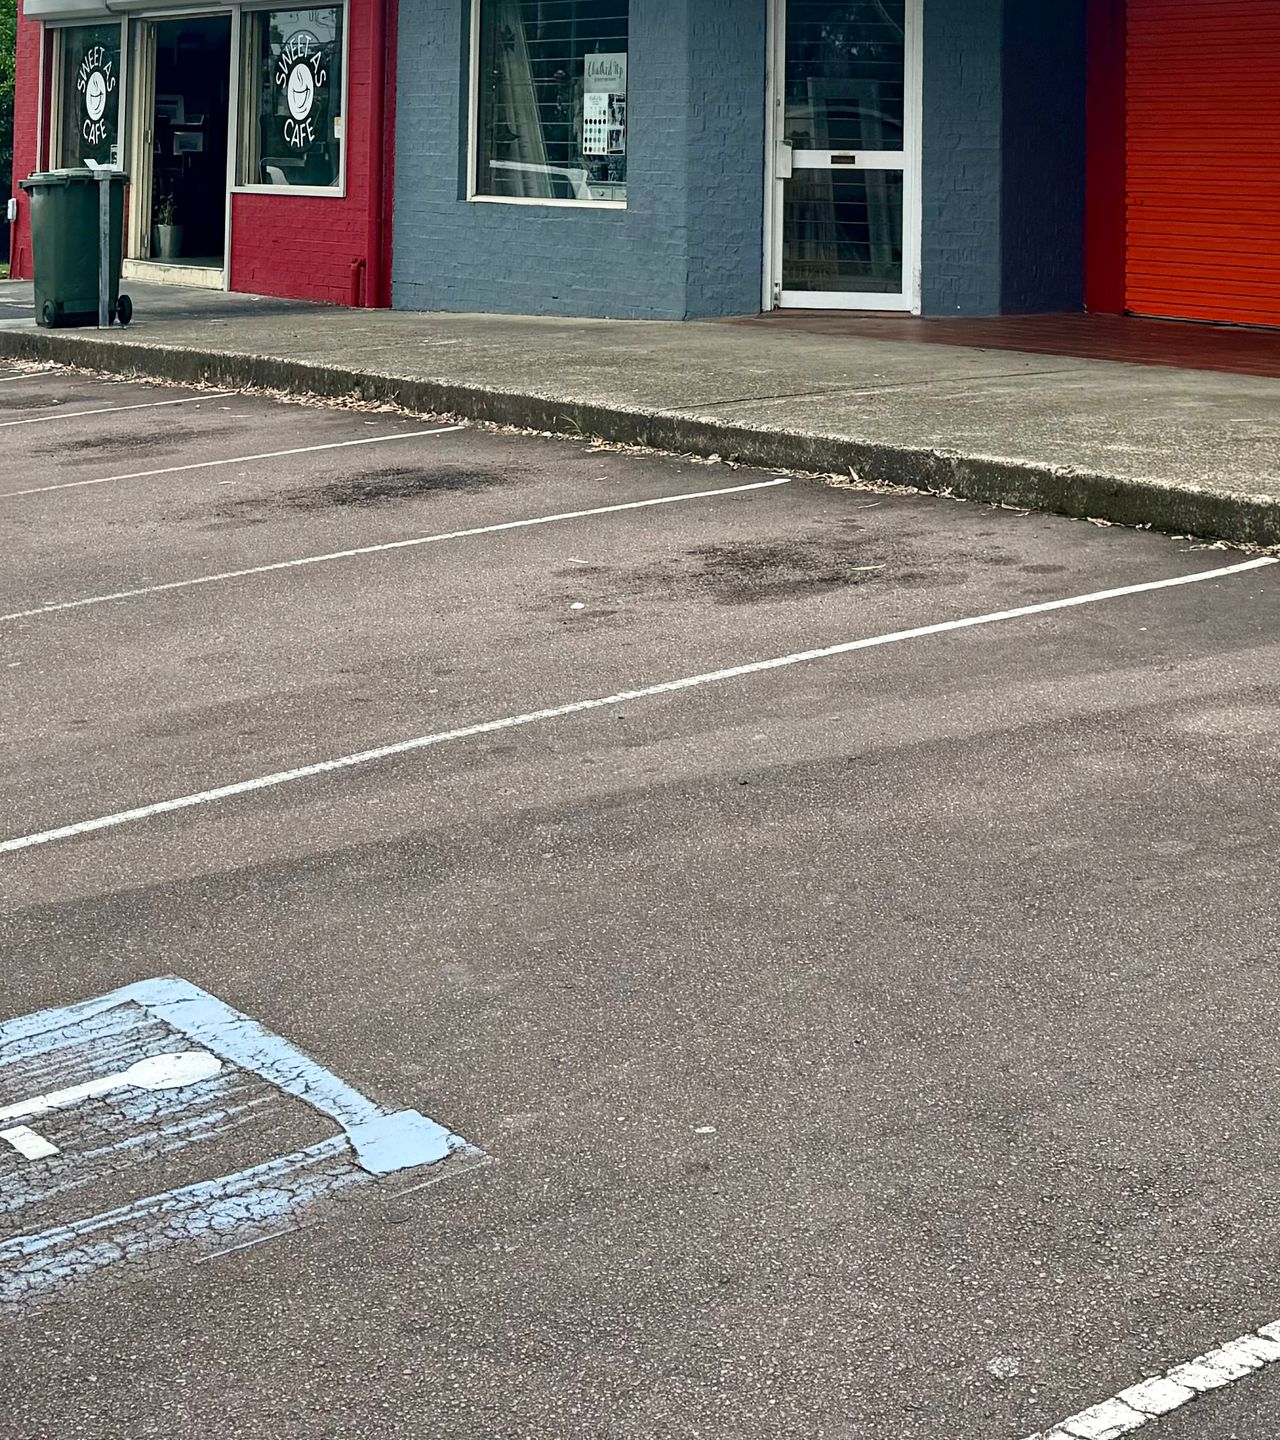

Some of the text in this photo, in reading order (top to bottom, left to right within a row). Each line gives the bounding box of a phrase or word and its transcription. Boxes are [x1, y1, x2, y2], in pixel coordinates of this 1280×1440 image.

[77, 46, 116, 93] SWEET AS
[276, 35, 327, 88] SWEET AS
[83, 119, 107, 145] CAFE
[284, 118, 315, 148] CAFE
